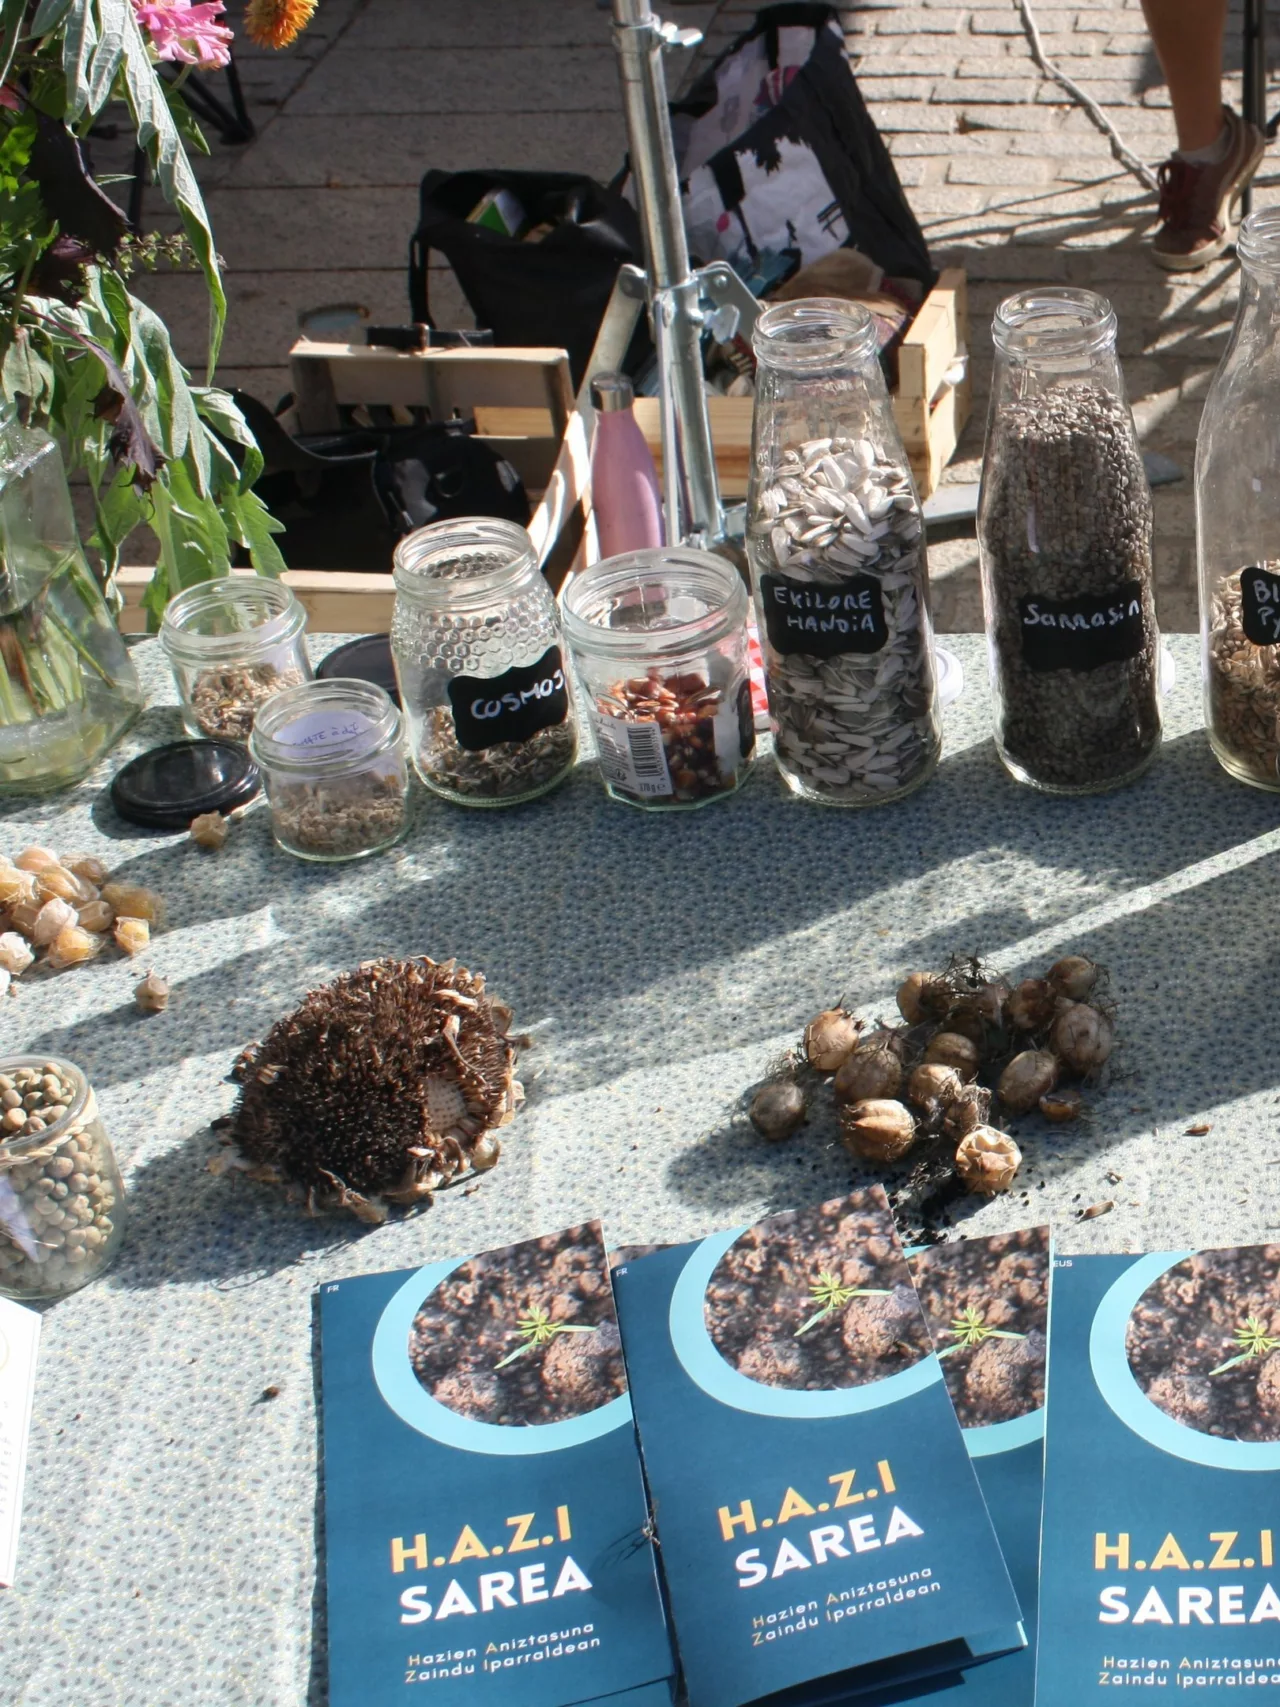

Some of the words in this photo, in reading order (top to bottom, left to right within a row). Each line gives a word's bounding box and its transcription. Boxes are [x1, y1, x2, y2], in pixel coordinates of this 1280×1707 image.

[470, 669, 565, 719] COSMOS
[616, 1267, 628, 1277] FR
[1053, 1259, 1073, 1268] EUS
[327, 1284, 340, 1293] FR
[718, 1459, 897, 1541] H.A.Z.I
[390, 1505, 572, 1573] H.A.Z.I
[735, 1506, 924, 1588] SAREA
[1094, 1529, 1273, 1570] H.A.Z.I
[400, 1556, 592, 1624] SAREA
[752, 1600, 818, 1629] Hazien
[826, 1567, 932, 1604] Aniztasuna
[752, 1613, 819, 1646] Zaindu
[827, 1581, 941, 1625] Iparraldean
[405, 1663, 475, 1683] Zaindu
[484, 1638, 600, 1672] Iparraldean
[409, 1648, 476, 1667] Hazien
[485, 1623, 594, 1655] Aniztasuna
[1103, 1655, 1170, 1670] Hazien
[1098, 1671, 1167, 1686] Zaindu
